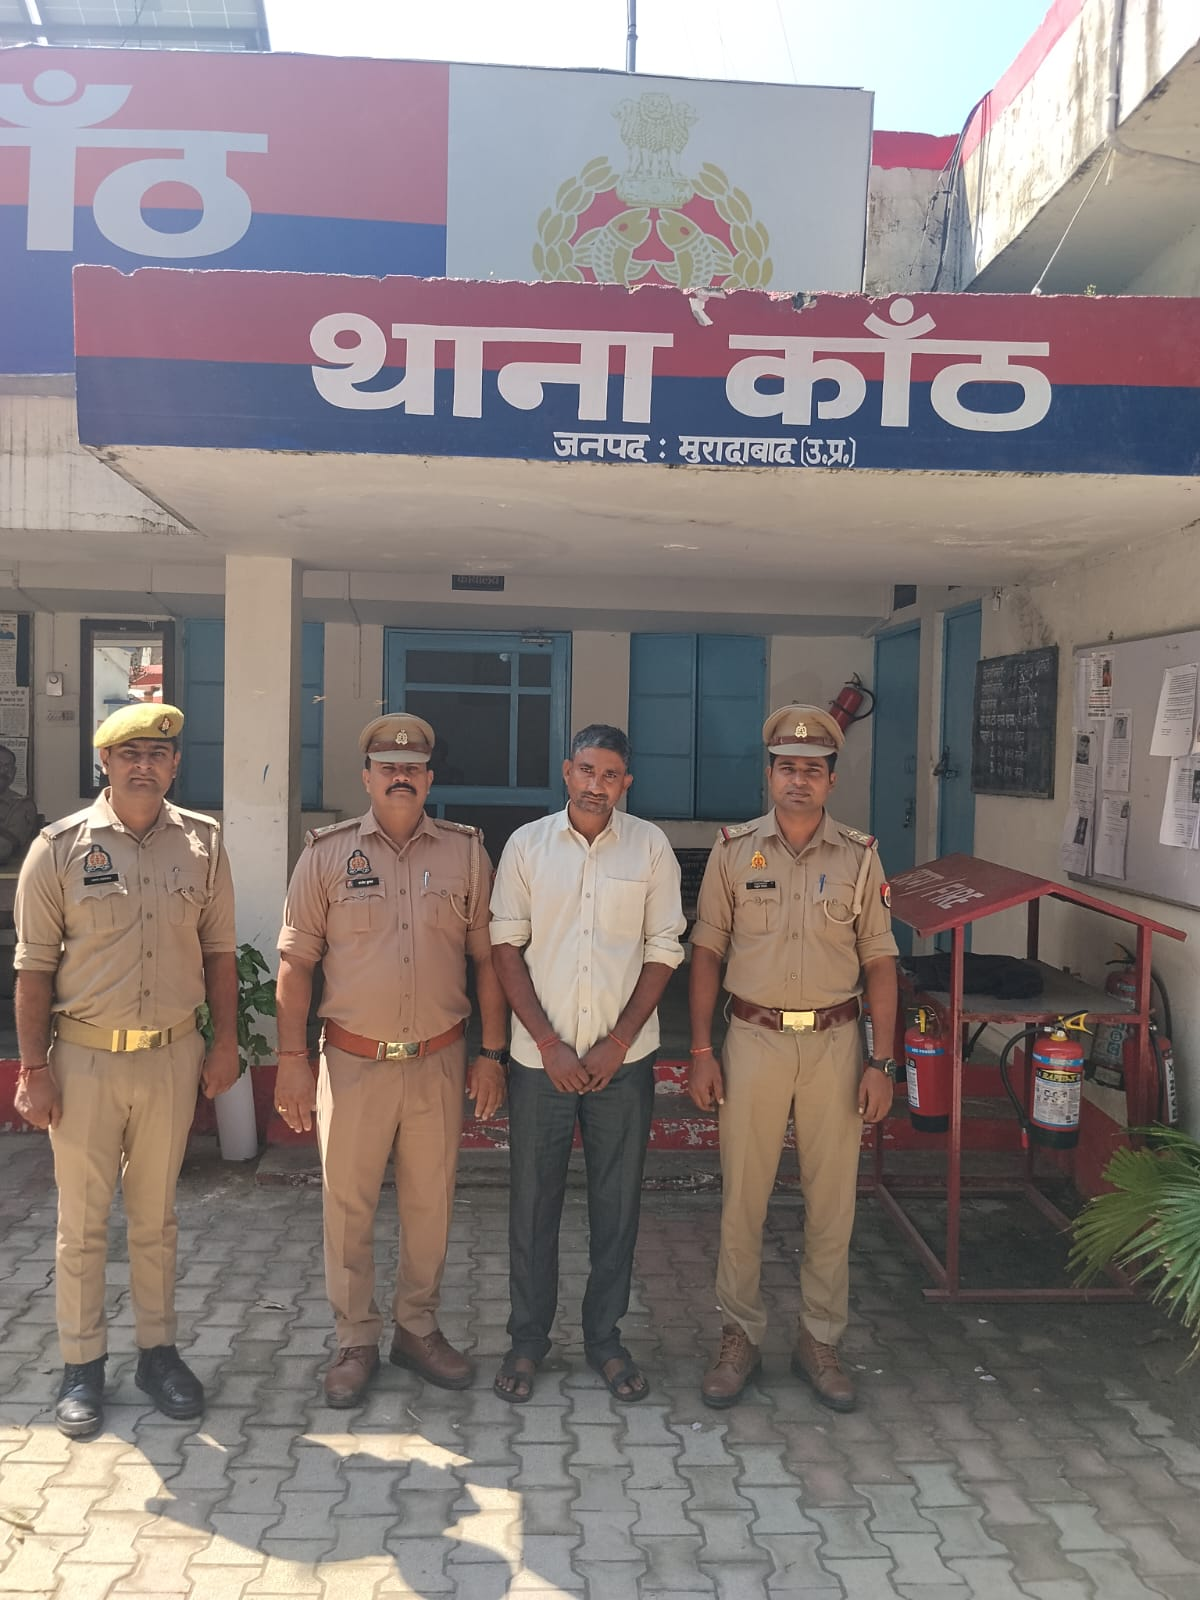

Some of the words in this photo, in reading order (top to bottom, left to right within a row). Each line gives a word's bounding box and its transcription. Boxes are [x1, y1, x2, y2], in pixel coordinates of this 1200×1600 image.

[0, 69, 268, 258] ाँठ
[309, 312, 674, 424] थाना
[553, 431, 650, 462] जनपद
[678, 435, 797, 465] मुरादाबाद
